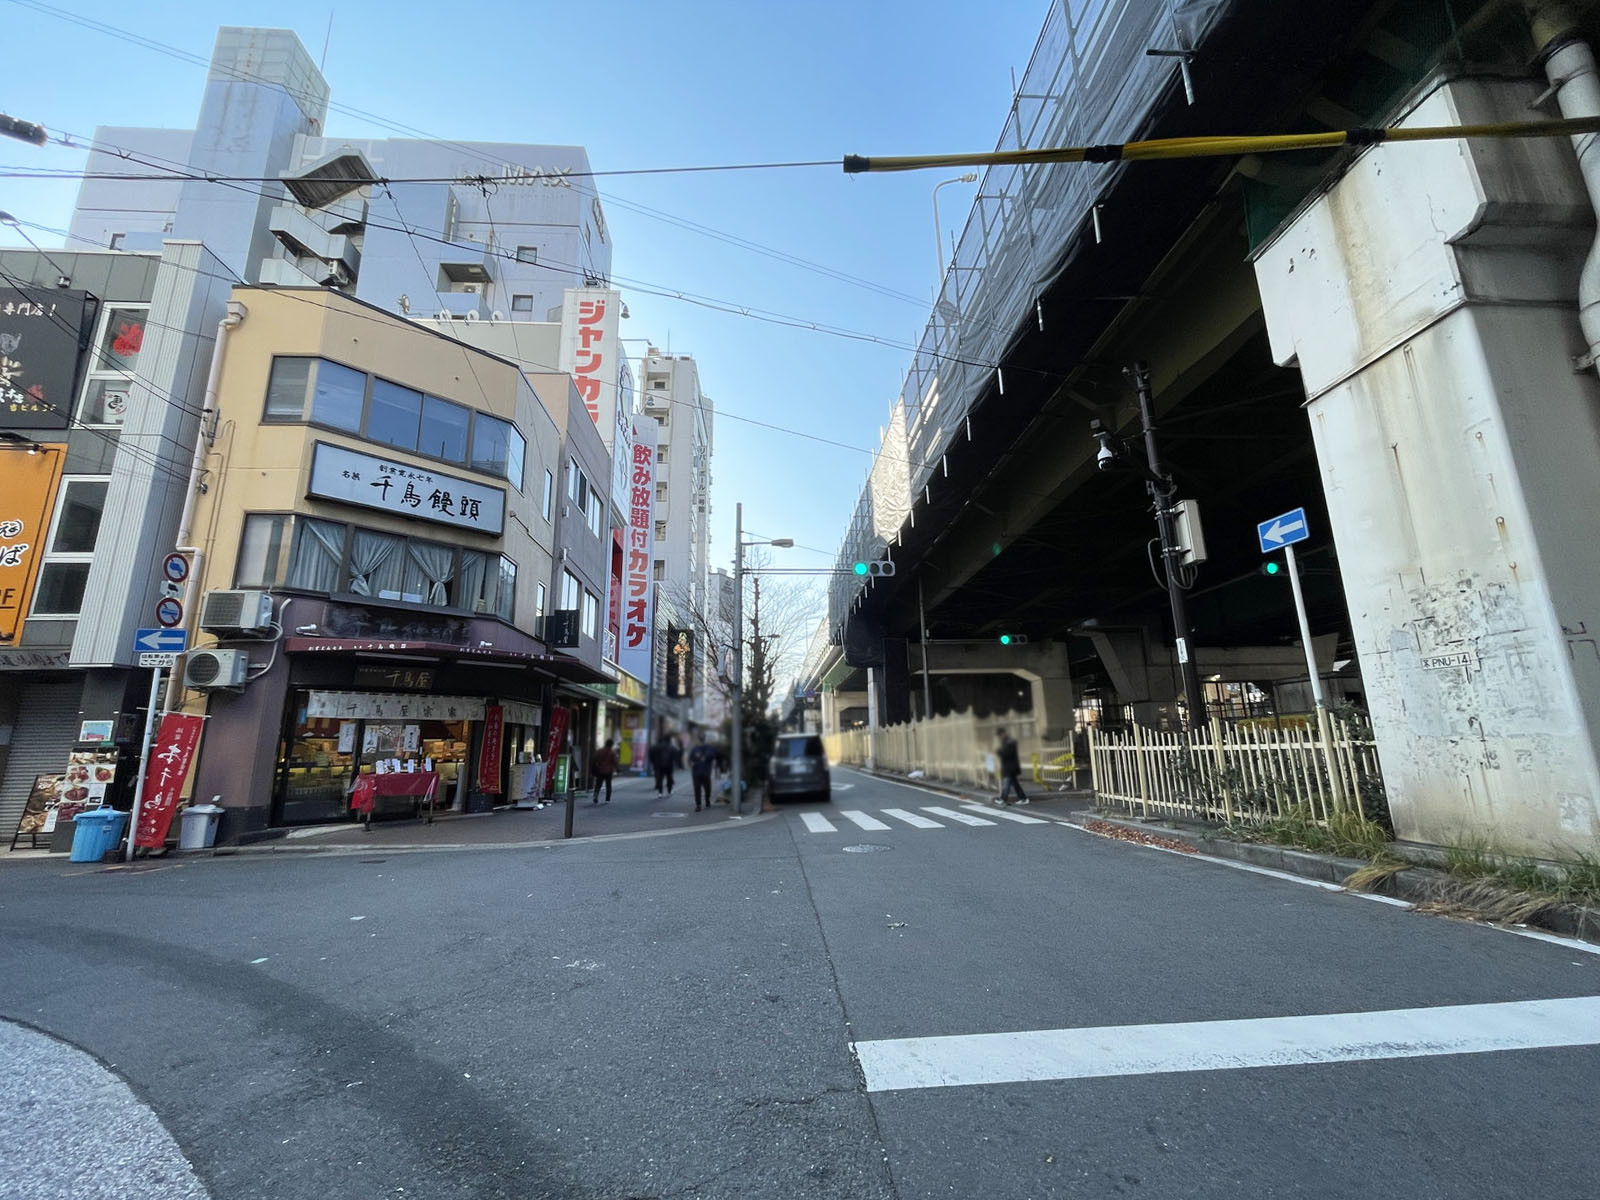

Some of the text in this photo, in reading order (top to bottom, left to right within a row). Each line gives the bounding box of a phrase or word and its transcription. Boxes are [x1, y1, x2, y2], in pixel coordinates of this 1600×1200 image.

[369, 475, 483, 521] 千鳥饅頭
[626, 443, 652, 649] 飲み放題付カラオケ
